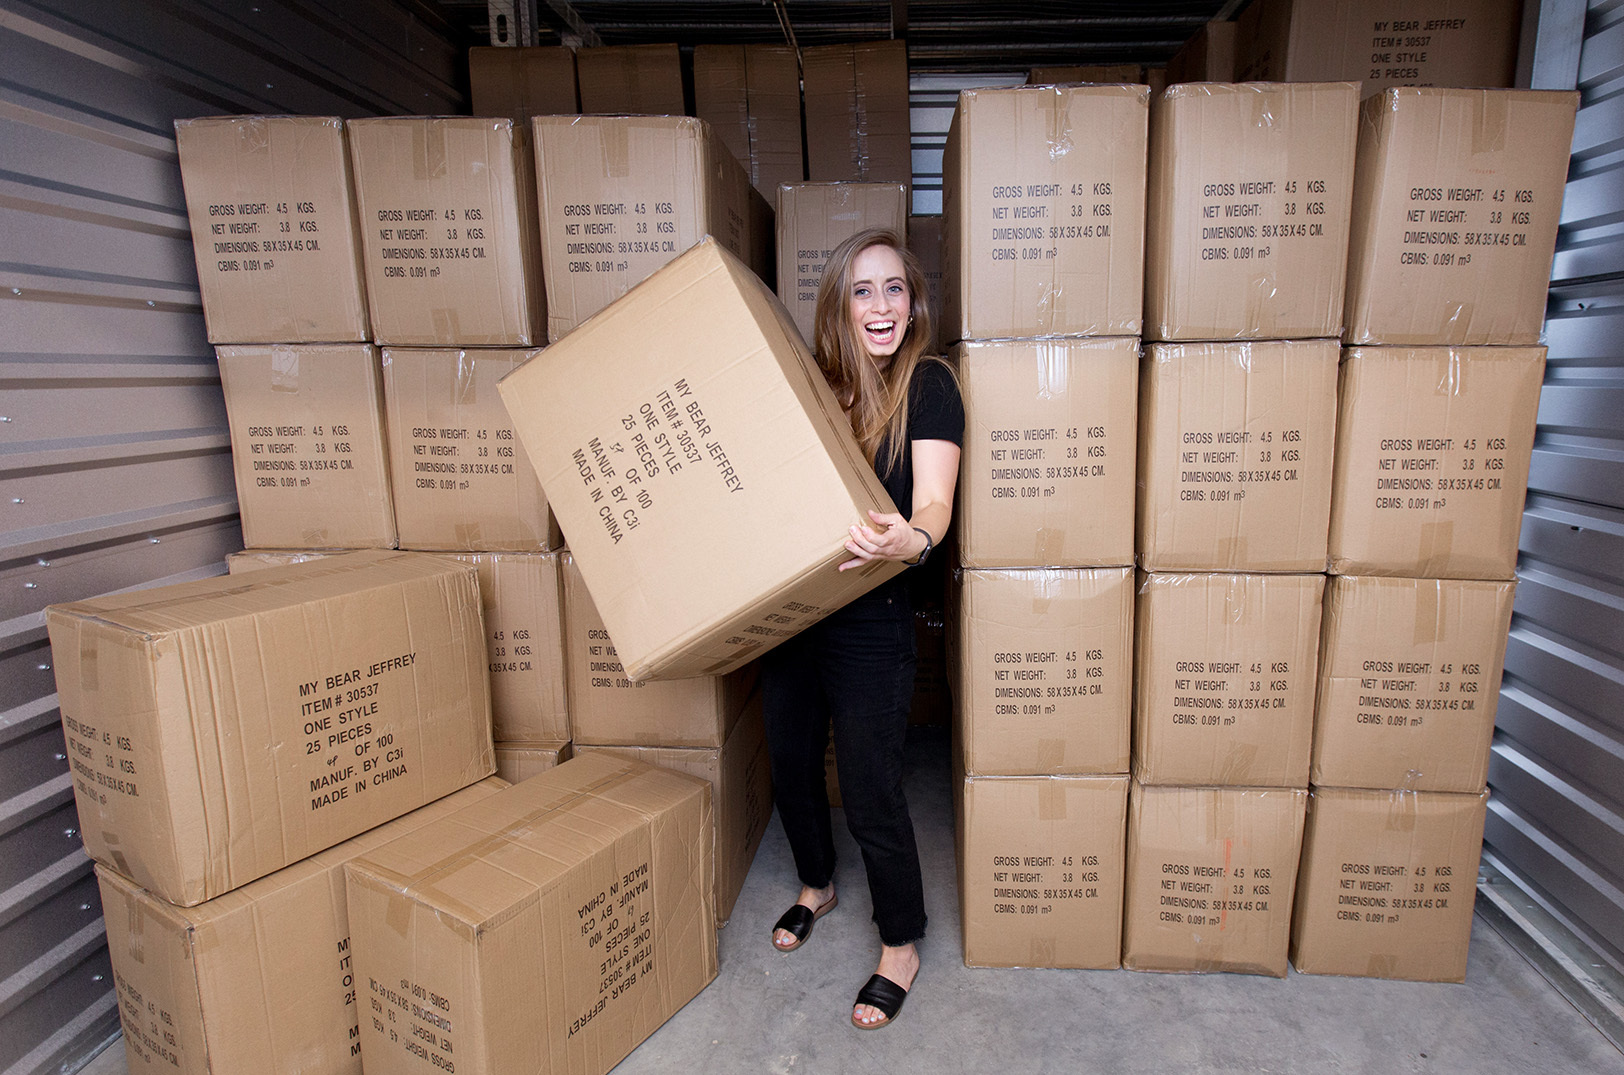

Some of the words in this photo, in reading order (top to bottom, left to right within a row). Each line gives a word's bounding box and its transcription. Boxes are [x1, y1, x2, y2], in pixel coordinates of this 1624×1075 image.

[1374, 22, 1388, 31] MY
[1393, 21, 1419, 31] BEAR
[1424, 19, 1465, 30] JEFFREY
[1405, 37, 1431, 46] 30537
[1371, 54, 1390, 63] ONE
[1396, 52, 1426, 62] STYLE
[1370, 69, 1380, 78] 25
[1385, 68, 1418, 78] PIECES
[993, 186, 1022, 198] GROSS
[1027, 184, 1062, 197] WEIGHT:
[1071, 184, 1082, 195] 4.5
[1094, 183, 1112, 195] KGS.
[1204, 184, 1235, 197] GROSS
[1240, 182, 1276, 195] WEIGHT:
[1285, 181, 1296, 193] 4.5
[1307, 181, 1326, 193] KGS.
[1410, 188, 1442, 201] GROSS
[1448, 189, 1484, 201] WEIGHT:
[1493, 190, 1505, 202] 4.5
[1515, 190, 1534, 203] KGS.
[209, 205, 235, 216] GROSS
[238, 203, 269, 215] WEIGHT:
[277, 203, 288, 213] 4.5
[297, 202, 316, 213] KGS.
[378, 210, 403, 221] GROSS
[406, 210, 437, 221] WEIGHT:
[445, 210, 455, 220] 4.5
[465, 209, 483, 220] KGS.
[564, 205, 591, 216] GROSS
[594, 204, 626, 215] WEIGHT:
[635, 203, 645, 214] 4.5
[655, 203, 674, 214] KGS.
[798, 250, 818, 258] GROSS
[249, 427, 273, 437] GROSS
[276, 426, 305, 436] WEIGHT:
[313, 426, 323, 436] 4.5
[332, 425, 350, 435] KGS.
[413, 428, 437, 438] GROSS
[440, 429, 469, 439] WEIGHT:
[477, 430, 487, 439] 4.5
[496, 430, 513, 440] KGS.
[639, 403, 659, 431] ONE
[654, 433, 682, 475] STYLE
[674, 378, 692, 398] MY
[686, 401, 711, 438] BEAR
[706, 441, 744, 494] JEFFREY
[991, 430, 1019, 441] GROSS
[1024, 429, 1057, 440] WEIGHT:
[1066, 428, 1077, 439] 4.5
[1088, 427, 1106, 438] KGS.
[1183, 433, 1212, 444] GROSS
[1217, 432, 1251, 443] WEIGHT:
[1261, 432, 1272, 442] 4.5
[1282, 430, 1301, 442] KGS.
[622, 414, 636, 431] 25
[631, 435, 659, 478] PIECES
[675, 430, 702, 464] 30537
[1381, 439, 1412, 450] GROSS
[1417, 439, 1454, 450] WEIGHT:
[1464, 439, 1476, 450] 4.5
[1487, 439, 1506, 450] KGS.
[588, 437, 616, 485] MANUF.
[611, 487, 627, 503] BY
[623, 510, 640, 530] C3i
[625, 468, 641, 485] OF
[636, 489, 652, 510] 100
[572, 449, 595, 486] MADE
[590, 488, 604, 503] IN
[599, 506, 623, 545] CHINA
[494, 631, 504, 640] 4.5
[513, 630, 531, 639] KGS.
[496, 648, 505, 656] 3.8
[515, 647, 532, 655] KGS.
[590, 646, 602, 655] NET
[994, 653, 1021, 663] GROSS
[1026, 652, 1057, 663] WEIGHT:
[1066, 651, 1076, 661] 4.5
[1086, 649, 1103, 660] KGS.
[299, 681, 318, 697] MY
[326, 670, 361, 689] BEAR
[367, 653, 416, 677] JEFFREY
[1176, 662, 1204, 673] GROSS
[1209, 663, 1241, 673] WEIGHT:
[1250, 663, 1261, 673] 4.5
[1271, 662, 1289, 673] KGS.
[1363, 661, 1393, 672] GROSS
[1398, 663, 1432, 673] WEIGHT:
[1440, 664, 1452, 674] 4.5
[1462, 664, 1481, 674] KGS.
[592, 678, 613, 687] CBMS:
[347, 683, 379, 702] 30537
[304, 717, 331, 734] ONE
[339, 702, 378, 724] STYLE
[306, 740, 320, 755] 25
[329, 723, 372, 747] PIECES
[355, 743, 370, 756] OF
[376, 734, 393, 748] 100
[310, 766, 357, 792] MANUF.
[364, 757, 378, 772] BY
[386, 748, 403, 762] C3i
[312, 787, 348, 810] MADE
[356, 780, 366, 793] IN
[374, 764, 407, 785] CHINA
[994, 856, 1020, 866] GROSS
[1024, 857, 1054, 866] WEIGHT:
[1062, 857, 1072, 866] 4.5
[1082, 856, 1099, 865] KGS.
[623, 863, 648, 887] MADE
[1162, 864, 1189, 875] GROSS
[1193, 867, 1226, 877] WEIGHT:
[1234, 869, 1244, 878] 4.5
[1254, 869, 1272, 878] KGS.
[1342, 863, 1370, 874] GROSS
[1374, 866, 1407, 876] WEIGHT:
[1415, 867, 1426, 876] 4.5
[1435, 866, 1452, 876] KGS.
[610, 882, 618, 895] IN
[578, 892, 605, 918] CHINA
[601, 904, 612, 921] BY
[607, 918, 618, 934] OF
[640, 911, 650, 925] 25
[581, 919, 595, 936] C3i
[589, 931, 602, 948] 100
[606, 922, 635, 952] PIECES
[633, 929, 650, 947] ONE
[601, 946, 628, 975] STYLE
[641, 960, 652, 977] MY
[600, 967, 622, 993] 30537
[612, 973, 636, 999] BEAR
[568, 997, 608, 1038] JEFFREY
